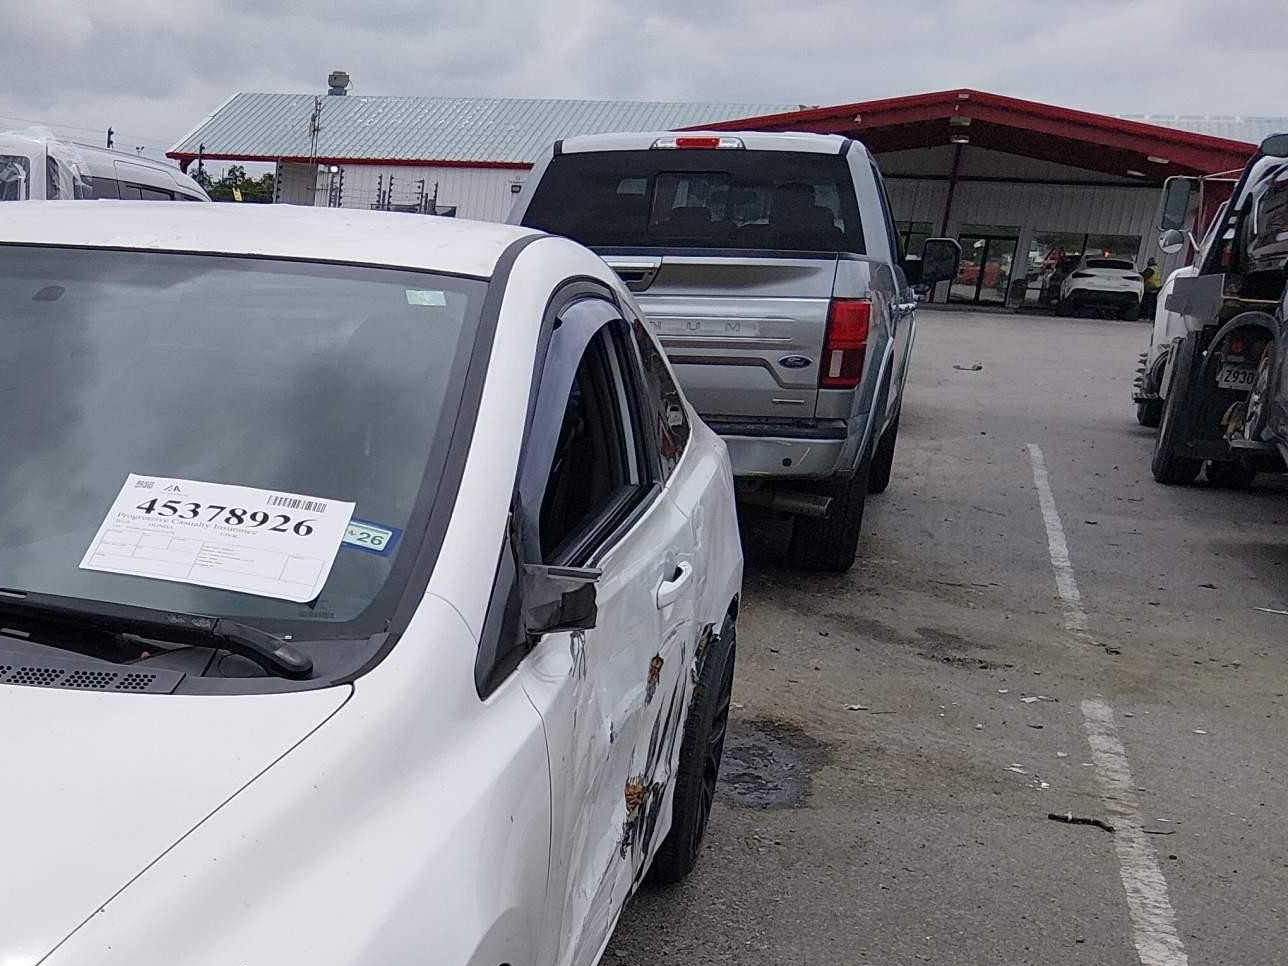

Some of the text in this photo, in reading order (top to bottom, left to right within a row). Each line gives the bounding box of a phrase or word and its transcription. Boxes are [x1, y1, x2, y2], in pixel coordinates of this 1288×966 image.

[117, 511, 171, 523] Progressive
[171, 518, 210, 530] Casualty
[136, 498, 318, 537] 45378926
[357, 532, 385, 546] 26
